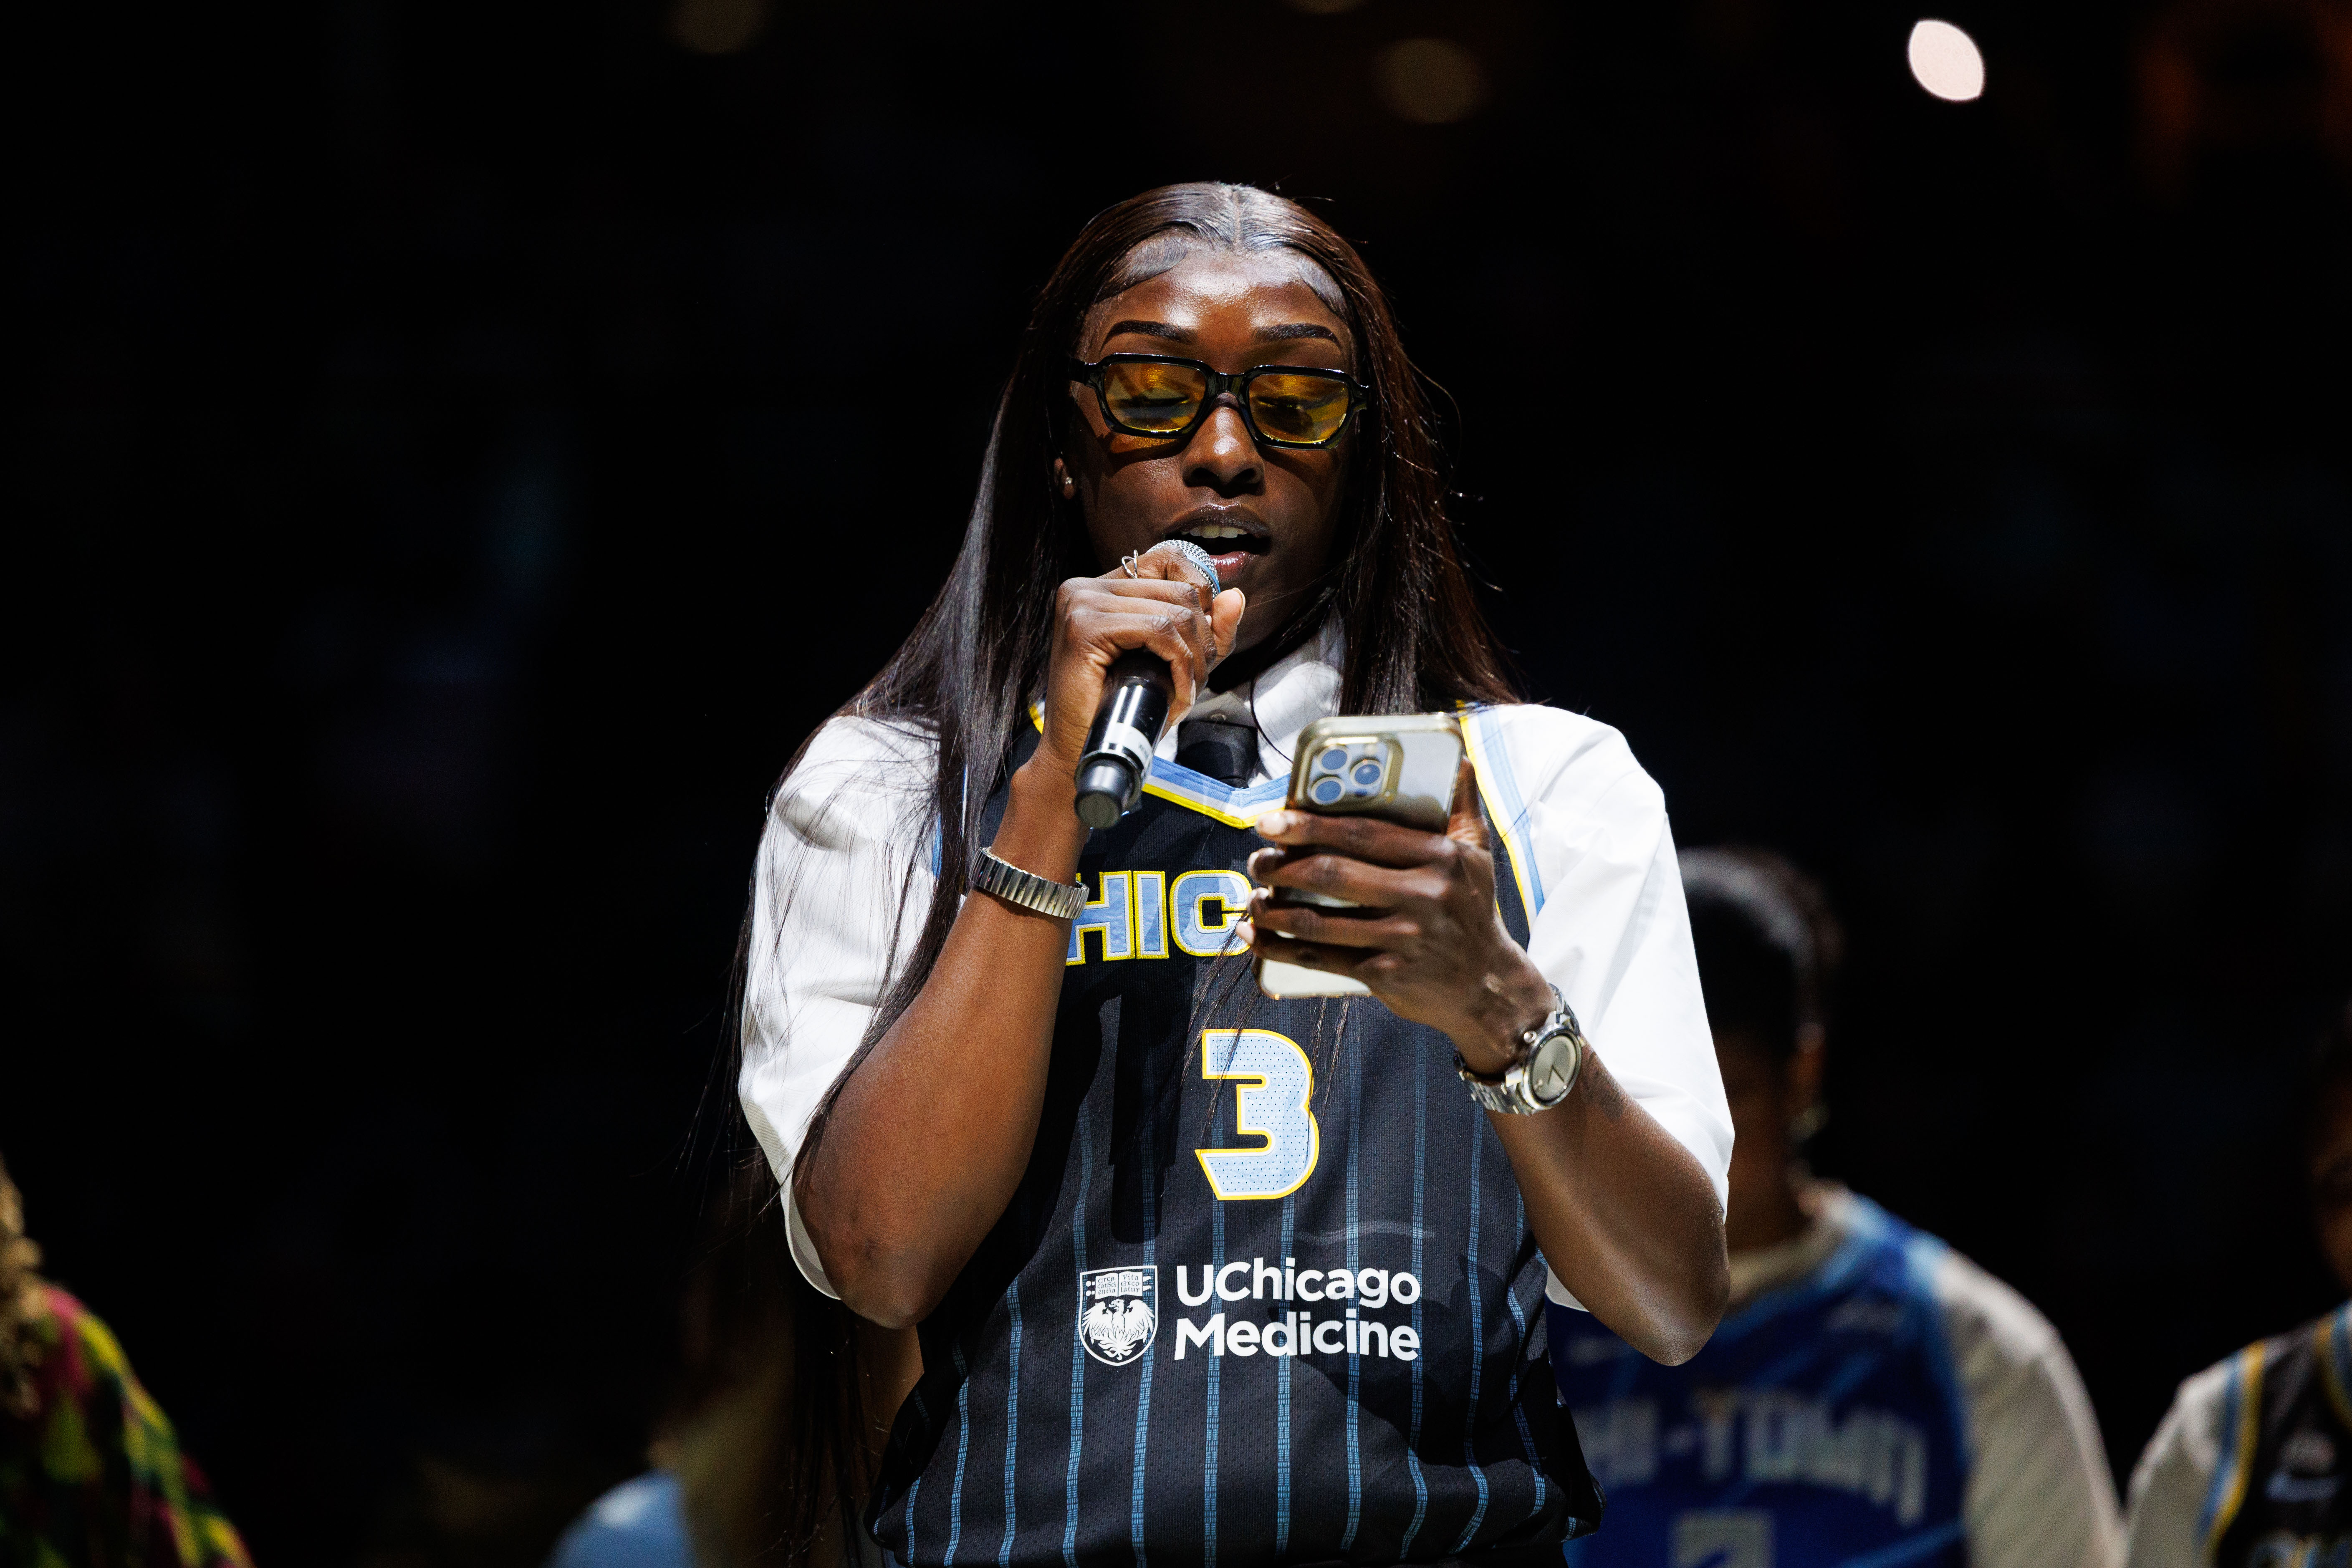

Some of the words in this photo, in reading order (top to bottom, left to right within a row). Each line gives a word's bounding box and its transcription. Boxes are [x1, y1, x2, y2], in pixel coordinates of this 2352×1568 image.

[1195, 1029, 1320, 1200] 3
[1177, 1257, 1420, 1308] UChicago
[1175, 1308, 1420, 1361] Medicine
